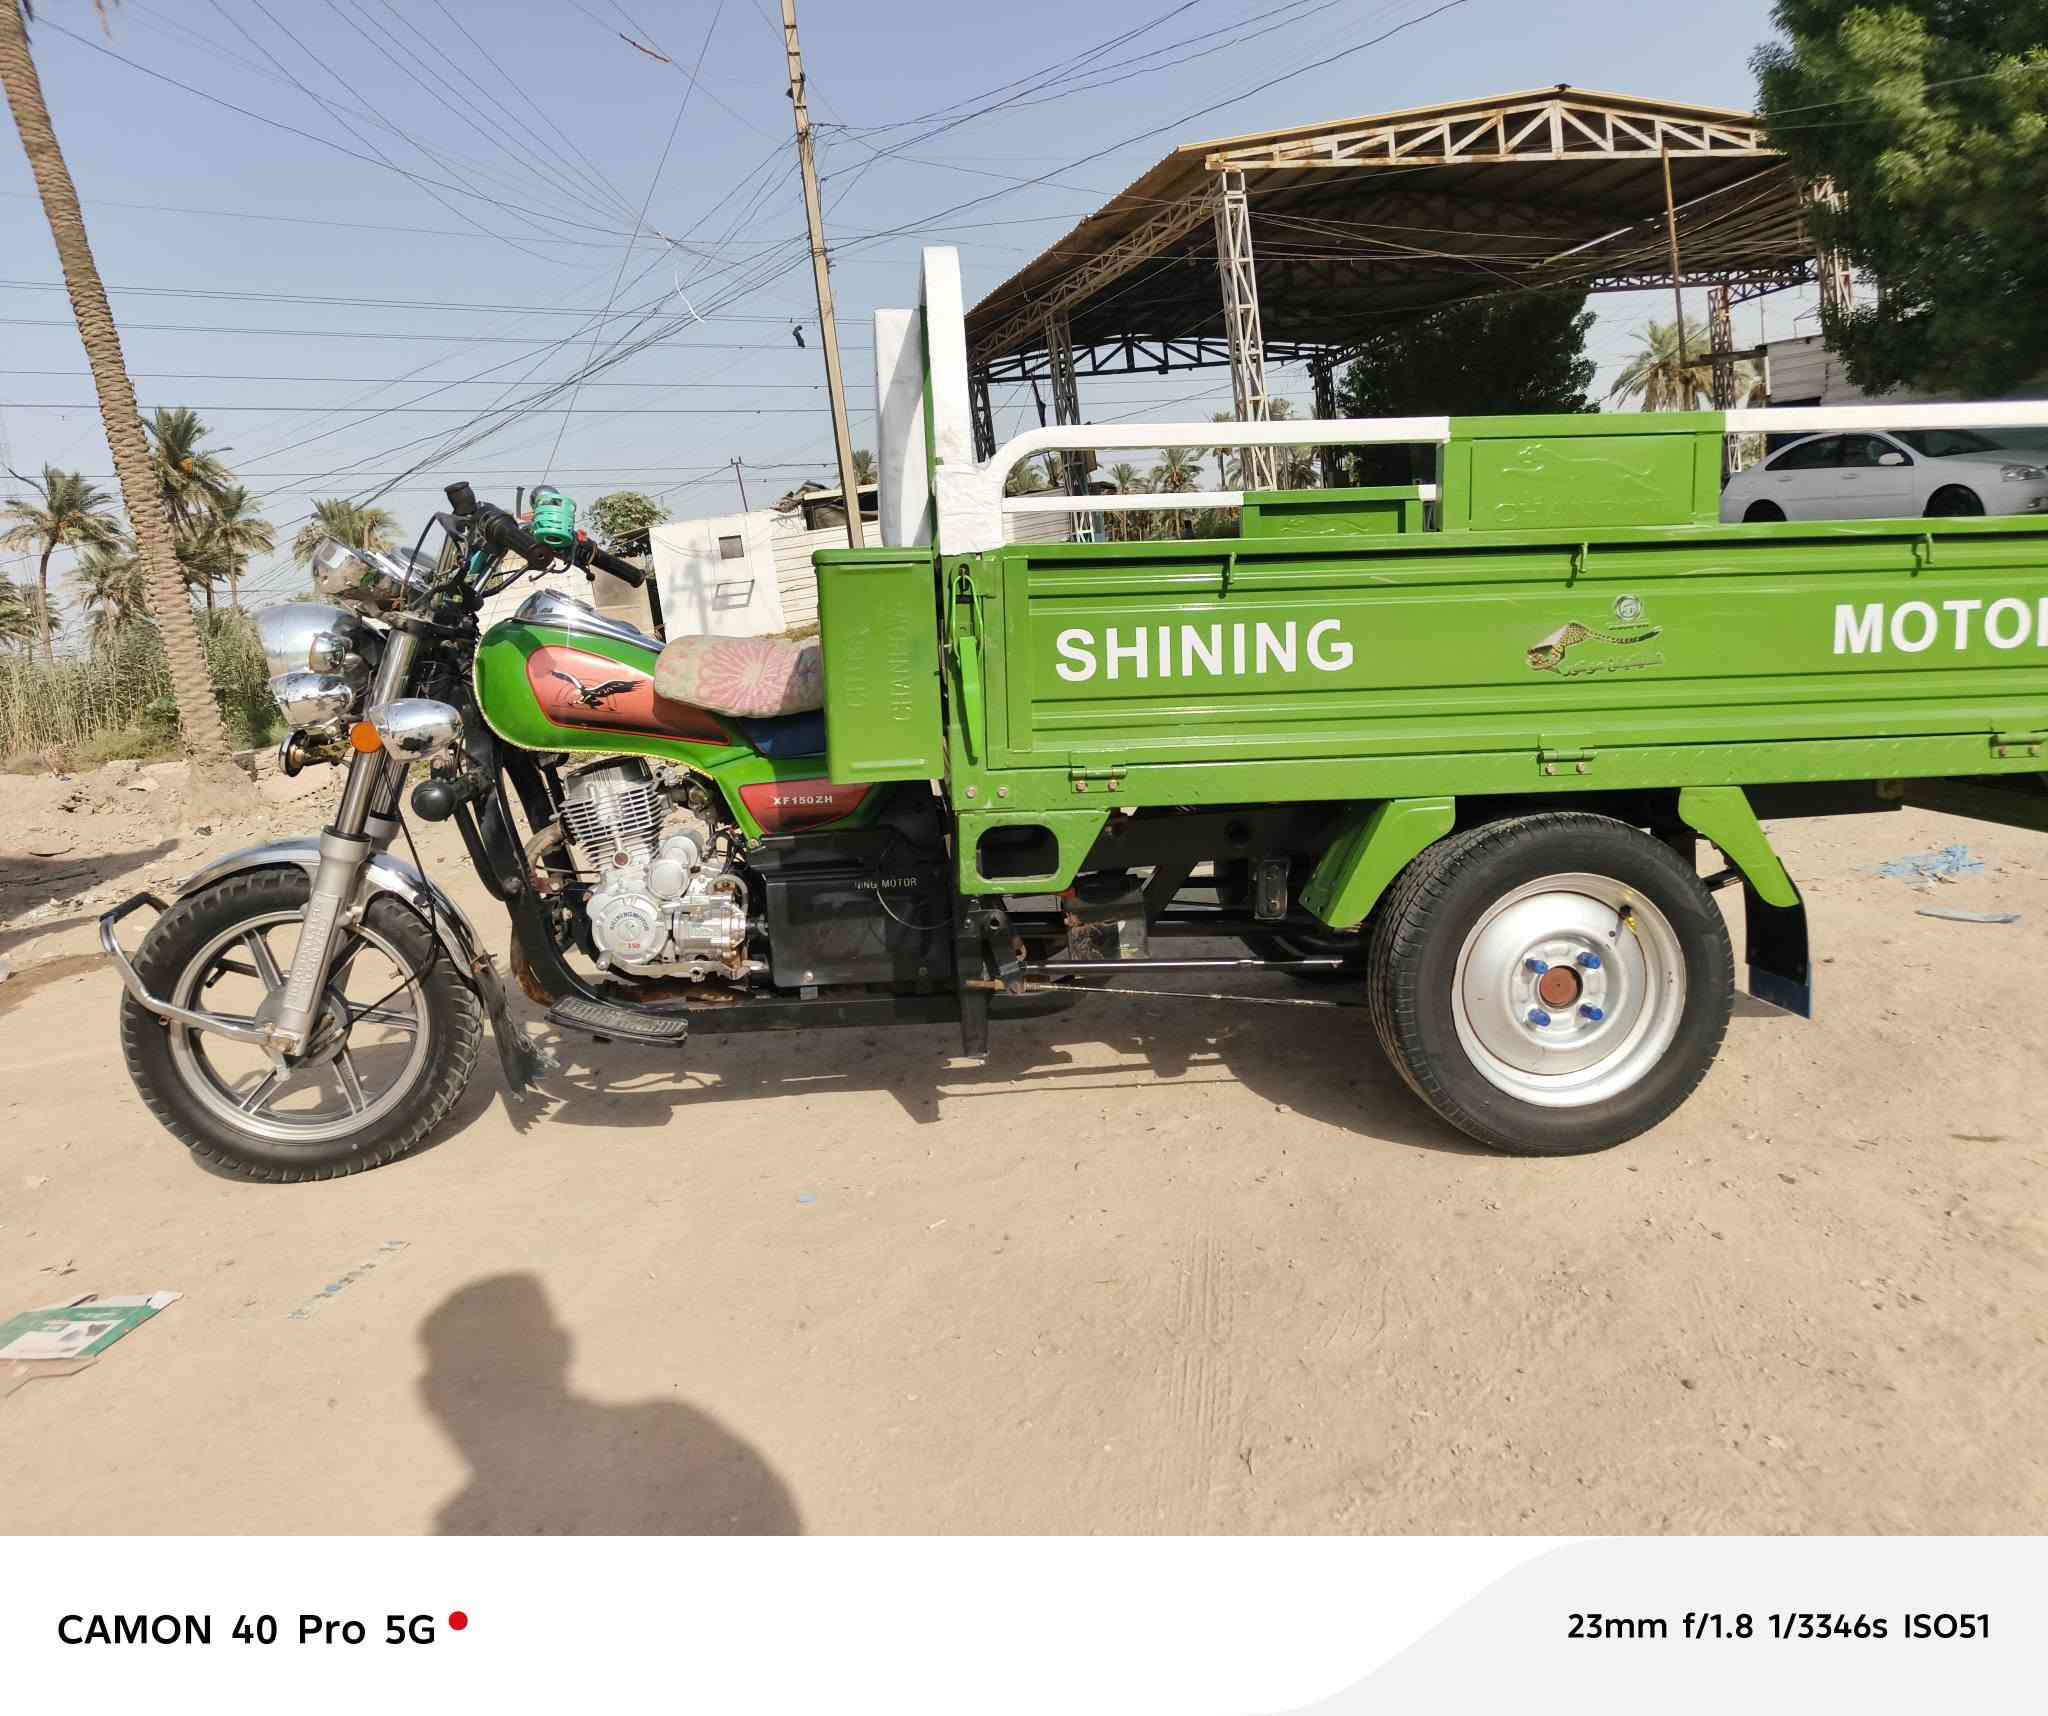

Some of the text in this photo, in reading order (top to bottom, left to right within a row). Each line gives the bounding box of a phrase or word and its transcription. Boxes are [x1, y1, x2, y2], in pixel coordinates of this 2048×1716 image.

[1055, 619, 1355, 682] SHINING
[773, 795, 833, 806] XF150ZH
[881, 877, 918, 888] MOTOR
